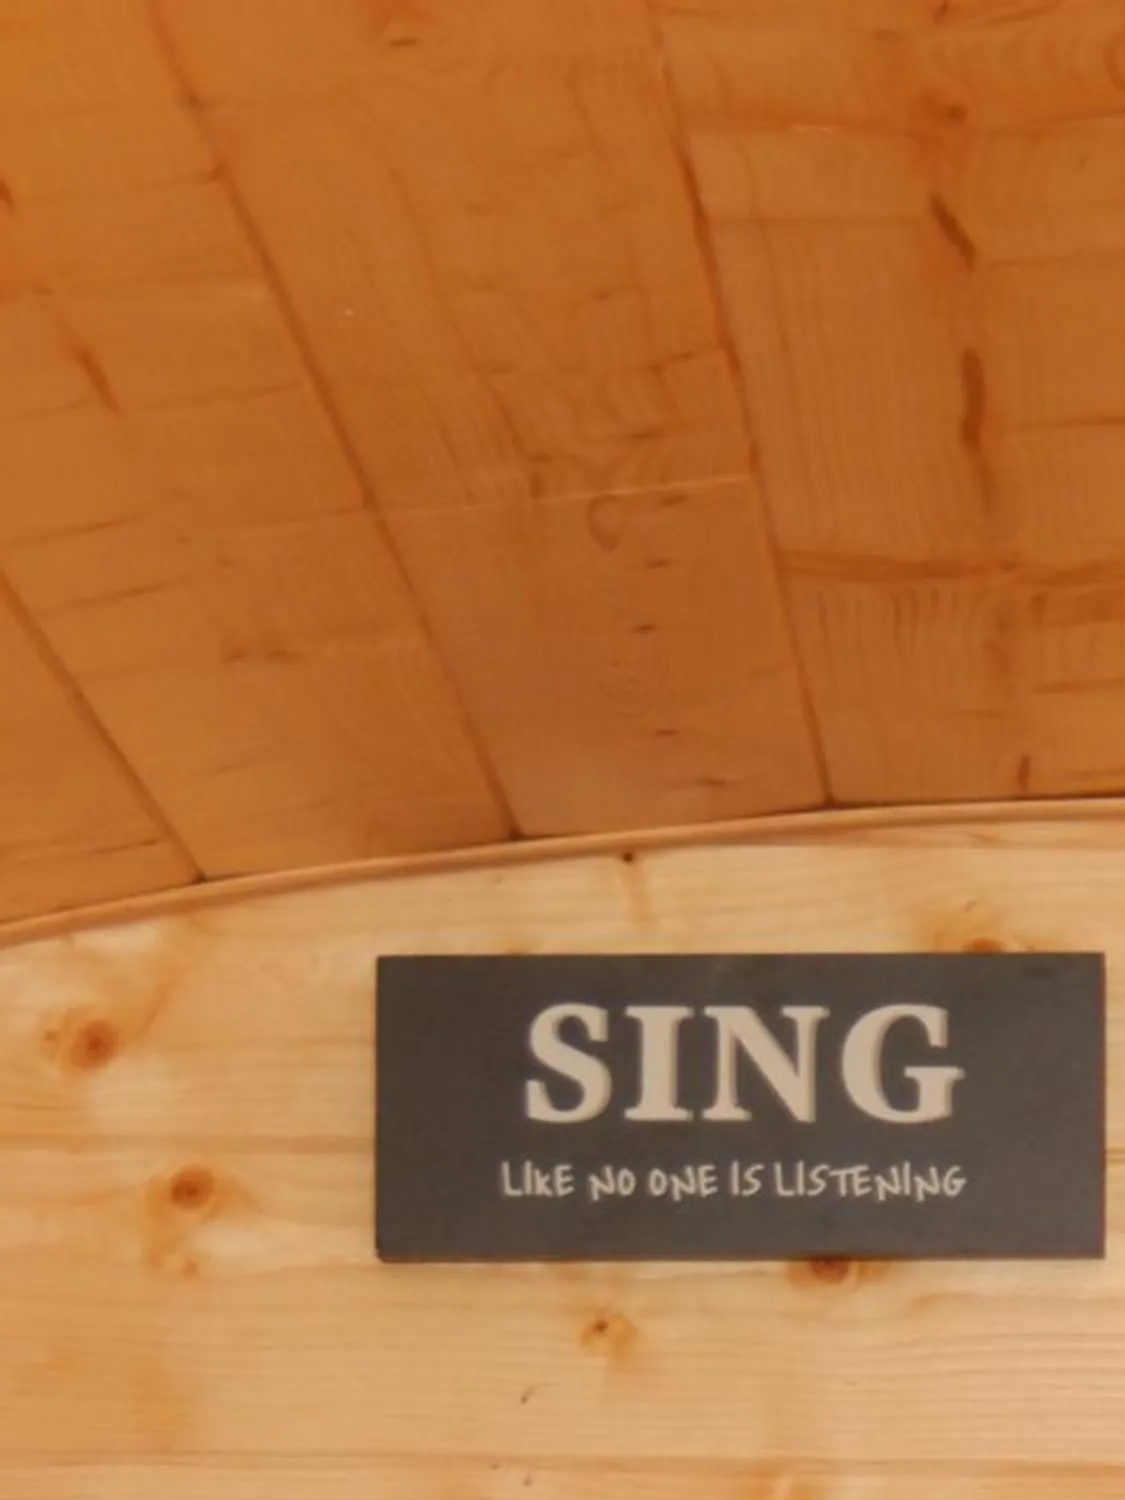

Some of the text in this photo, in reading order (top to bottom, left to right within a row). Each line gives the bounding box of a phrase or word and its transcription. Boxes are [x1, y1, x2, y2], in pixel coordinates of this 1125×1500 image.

[521, 1002, 965, 1125] SING
[588, 1165, 638, 1202] NO
[648, 1163, 719, 1203] ONE
[730, 1160, 766, 1198] IS
[773, 1159, 968, 1204] LISTENING
